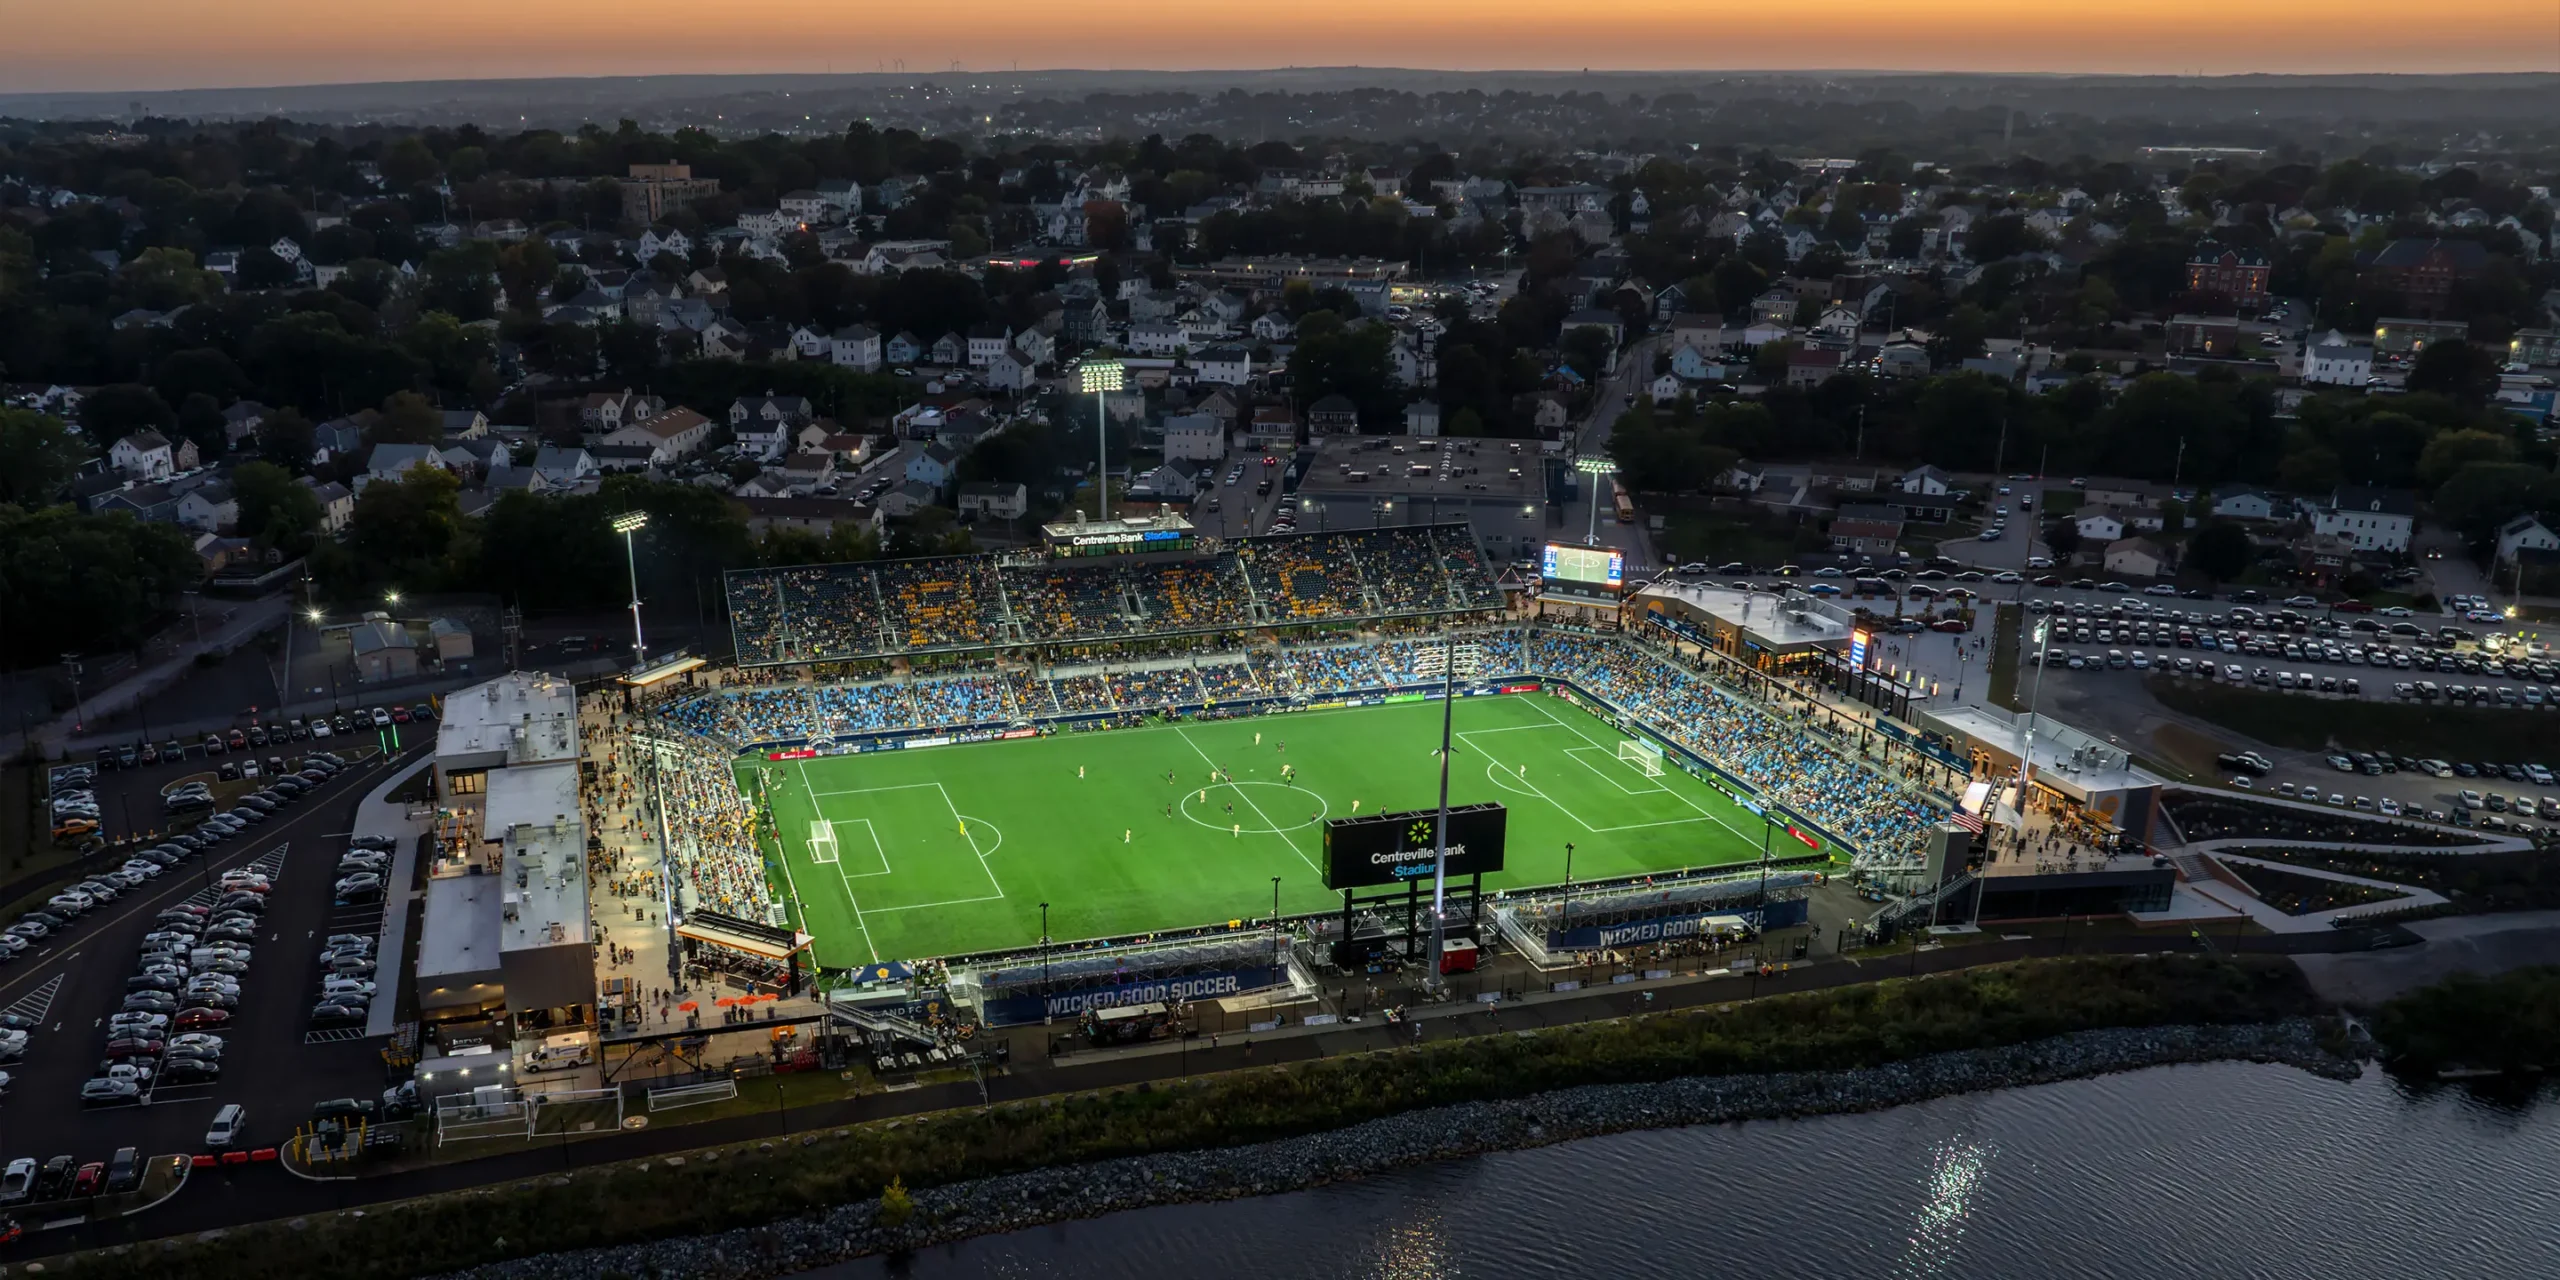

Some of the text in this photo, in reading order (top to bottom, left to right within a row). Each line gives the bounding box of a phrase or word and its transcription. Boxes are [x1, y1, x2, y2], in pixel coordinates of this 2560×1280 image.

[1073, 530, 1180, 546] Centreville Bank Stadium
[1371, 843, 1466, 865] Centreville ank
[1599, 923, 1659, 947] WICKED
[1047, 975, 1241, 1015] WICKED GOOD SOCCER.
[452, 1037, 484, 1046] harvey
